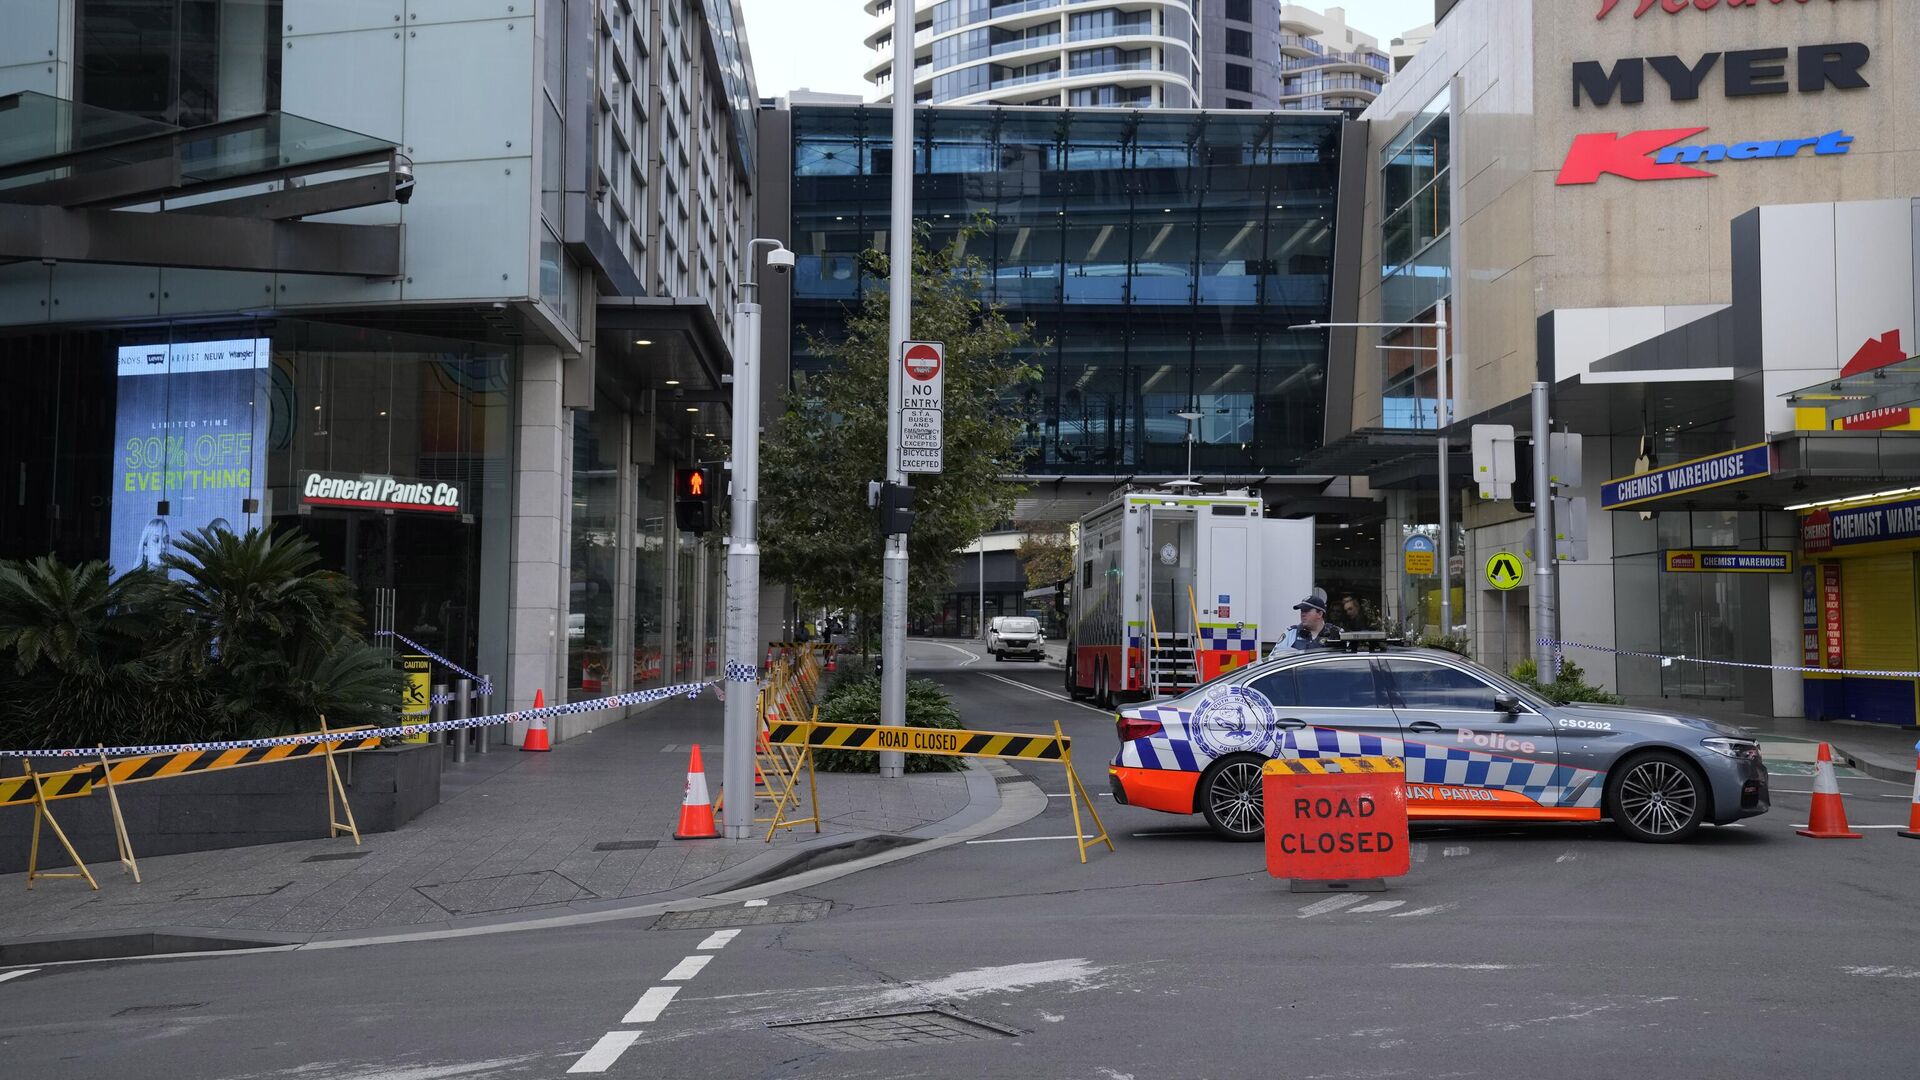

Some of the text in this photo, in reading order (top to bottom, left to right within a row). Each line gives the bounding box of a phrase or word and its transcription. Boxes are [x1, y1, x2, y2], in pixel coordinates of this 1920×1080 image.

[1572, 41, 1871, 108] MYER
[1554, 126, 1855, 185] Kmart
[204, 352, 225, 361] NEUW
[228, 349, 254, 361] Wrangler
[912, 384, 932, 396] NO
[904, 398, 939, 408] ENTRY
[151, 419, 228, 429] LIMITED TIME
[125, 432, 252, 469] 30% OFF
[903, 449, 939, 457] BICYCLES
[902, 459, 939, 468] EXCEPTED
[124, 467, 251, 492] EVERYTHING
[1617, 454, 1744, 501] CHEMIST WAREHOUSE
[304, 473, 460, 506] General Pants Co.
[1804, 523, 1831, 539] CHEMIST
[1833, 505, 1920, 540] CHEMIST WARE
[1703, 557, 1736, 566] CHEMIST
[1738, 557, 1785, 567] WAREHOUSE
[404, 661, 428, 669] CAUTION
[1211, 698, 1229, 711] SOUTH
[878, 730, 957, 751] ROAD CLOSED
[1248, 728, 1262, 746] FORCE
[1456, 728, 1536, 754] Police
[1439, 787, 1499, 801] PATROL
[1294, 798, 1376, 819] ROAD
[1280, 831, 1394, 854] CLOSED
